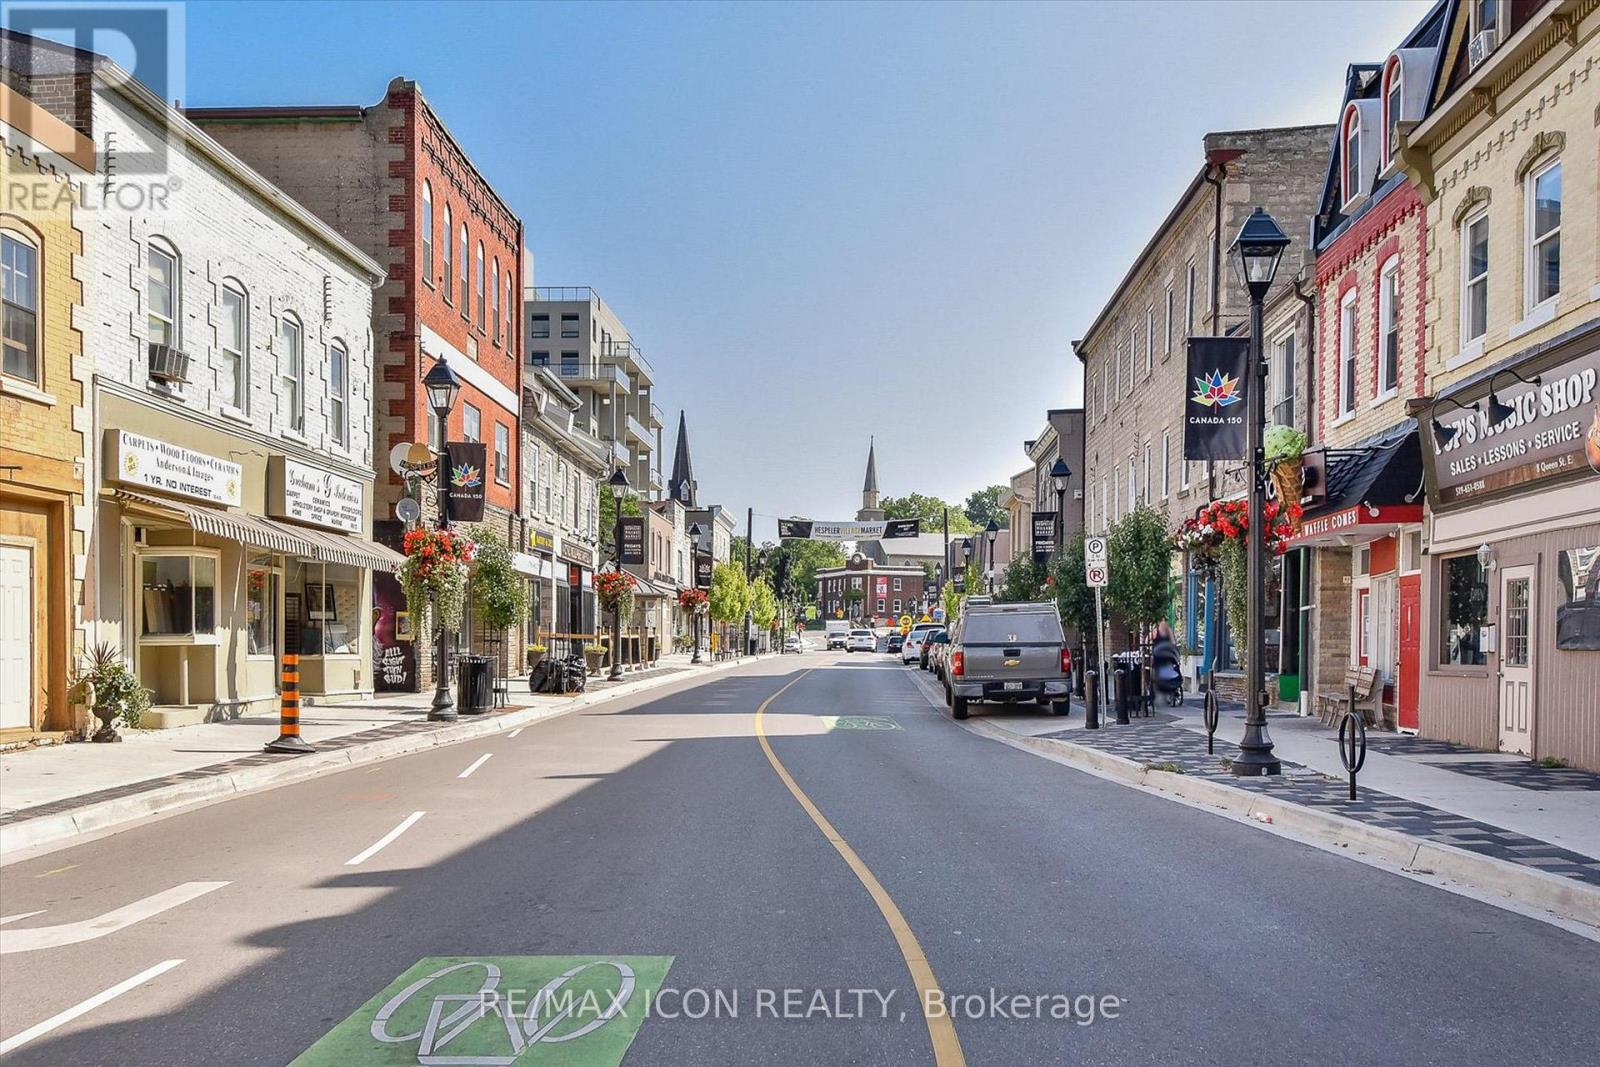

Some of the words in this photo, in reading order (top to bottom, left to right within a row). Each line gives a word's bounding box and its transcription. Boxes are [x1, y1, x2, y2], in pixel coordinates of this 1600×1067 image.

[1540, 368, 1597, 418] SHOP
[1189, 416, 1225, 425] CANADA
[1226, 416, 1242, 425] 150
[122, 433, 155, 452] CARPETS
[160, 443, 180, 459] WOOD
[182, 449, 207, 465] FLOORS
[210, 457, 239, 475] CERAMICS
[1450, 455, 1477, 476] SALES
[1483, 439, 1527, 466] LESSONS
[1535, 421, 1581, 450] SERVICE
[144, 473, 148, 482] 1
[165, 479, 177, 489] NO
[180, 483, 212, 498] INTEREST
[814, 526, 840, 535] HESPELER
[861, 526, 882, 534] MARKET
[1304, 518, 1328, 537] WAFFLE
[1331, 510, 1356, 529] CONES
